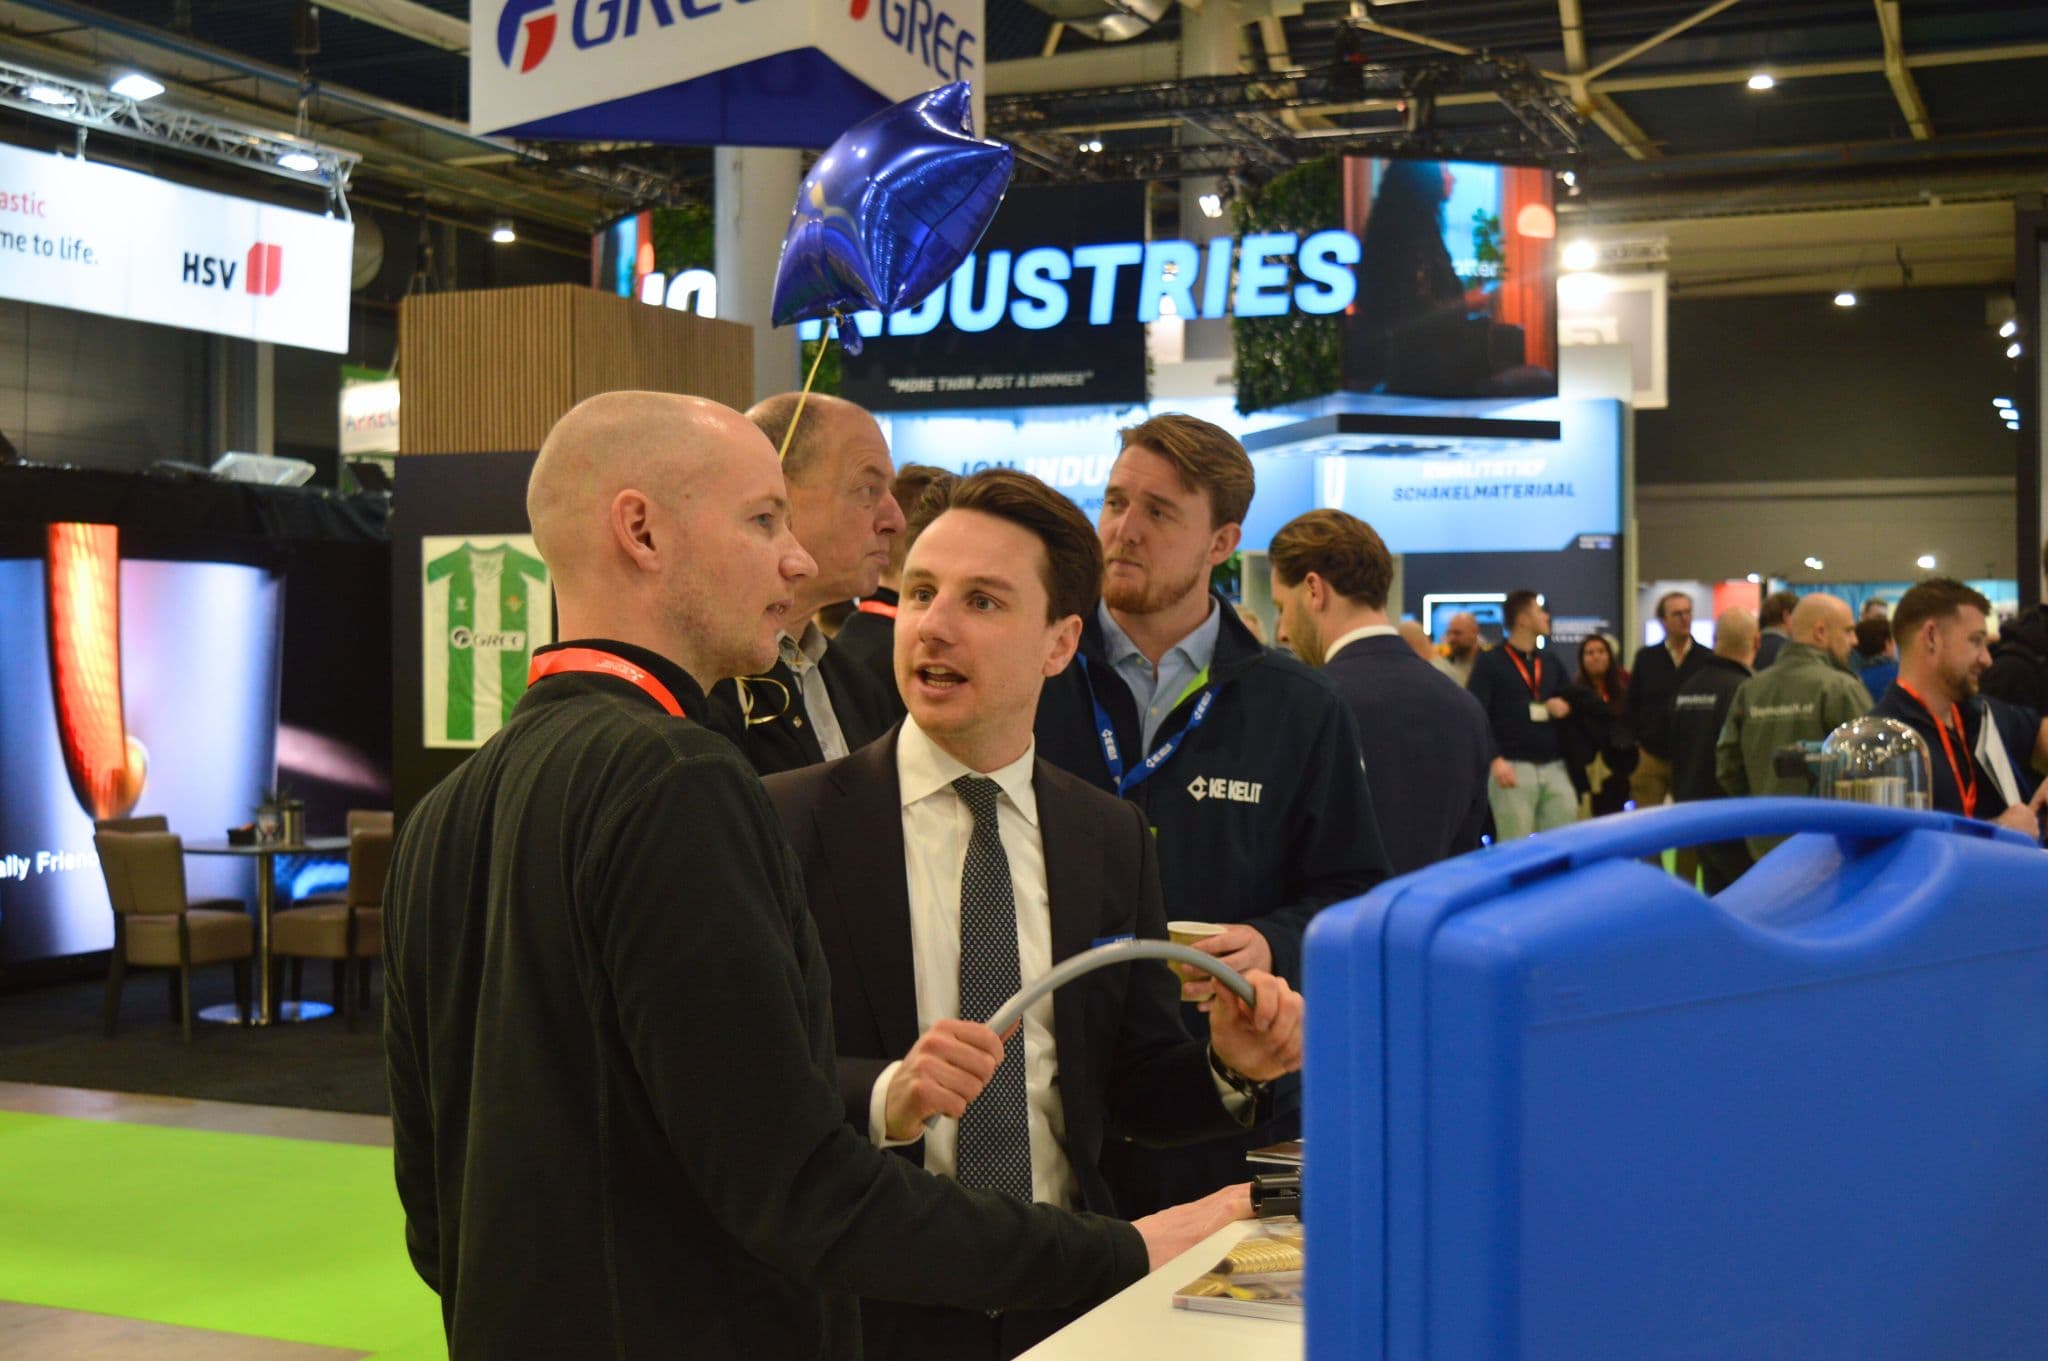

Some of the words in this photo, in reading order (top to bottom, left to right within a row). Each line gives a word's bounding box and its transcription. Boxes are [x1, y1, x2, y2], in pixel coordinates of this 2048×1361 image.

[33, 234, 54, 257] to
[60, 237, 99, 265] life.
[183, 251, 237, 290] HSV
[797, 230, 1362, 341] USTRIES
[976, 374, 1016, 389] JUST
[1015, 373, 1028, 388] A
[1025, 455, 1116, 487] INDU
[1392, 482, 1577, 501] SCHAKELMATERIAAL
[1208, 777, 1227, 799] KE
[1227, 779, 1263, 804] KELIT
